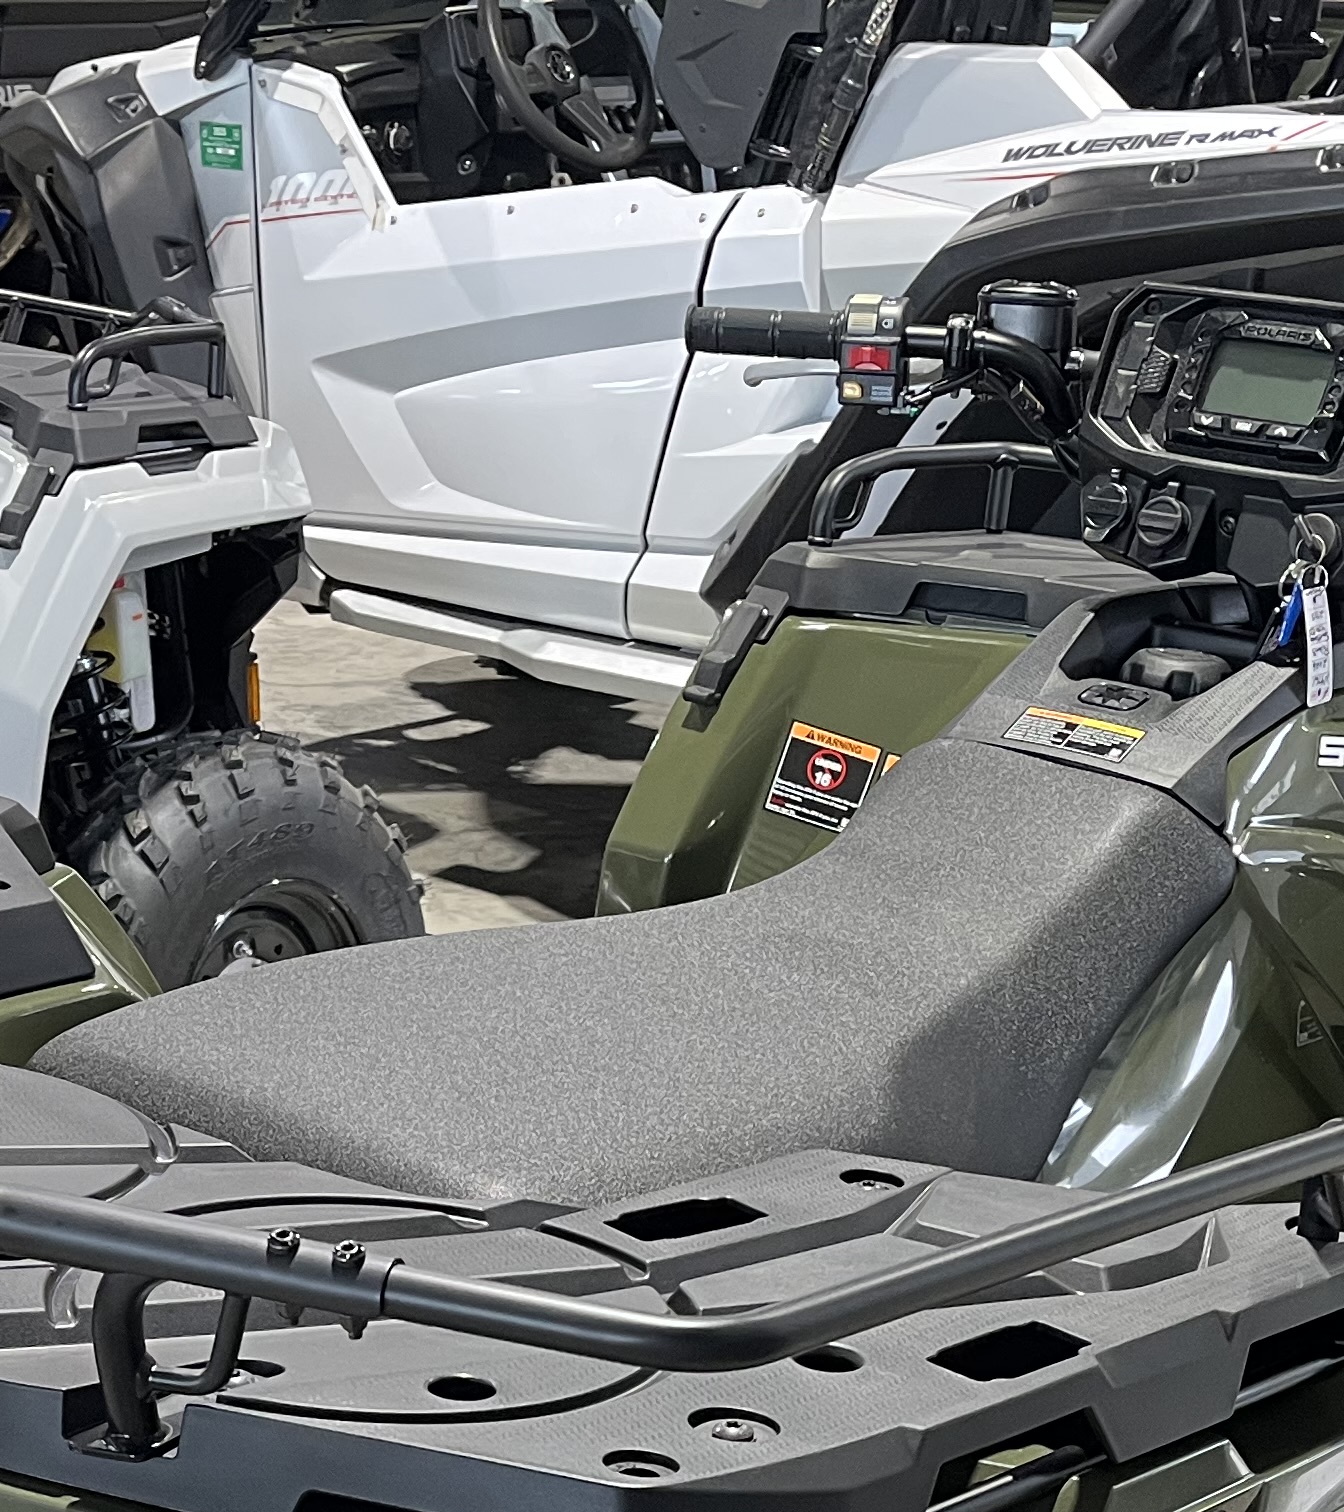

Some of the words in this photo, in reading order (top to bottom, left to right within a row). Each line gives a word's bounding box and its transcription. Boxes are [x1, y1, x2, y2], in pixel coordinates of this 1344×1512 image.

[1002, 130, 1188, 164] WOLVERINE
[1244, 325, 1314, 342] POLARIS
[816, 732, 863, 755] WARNING
[814, 770, 833, 787] 16
